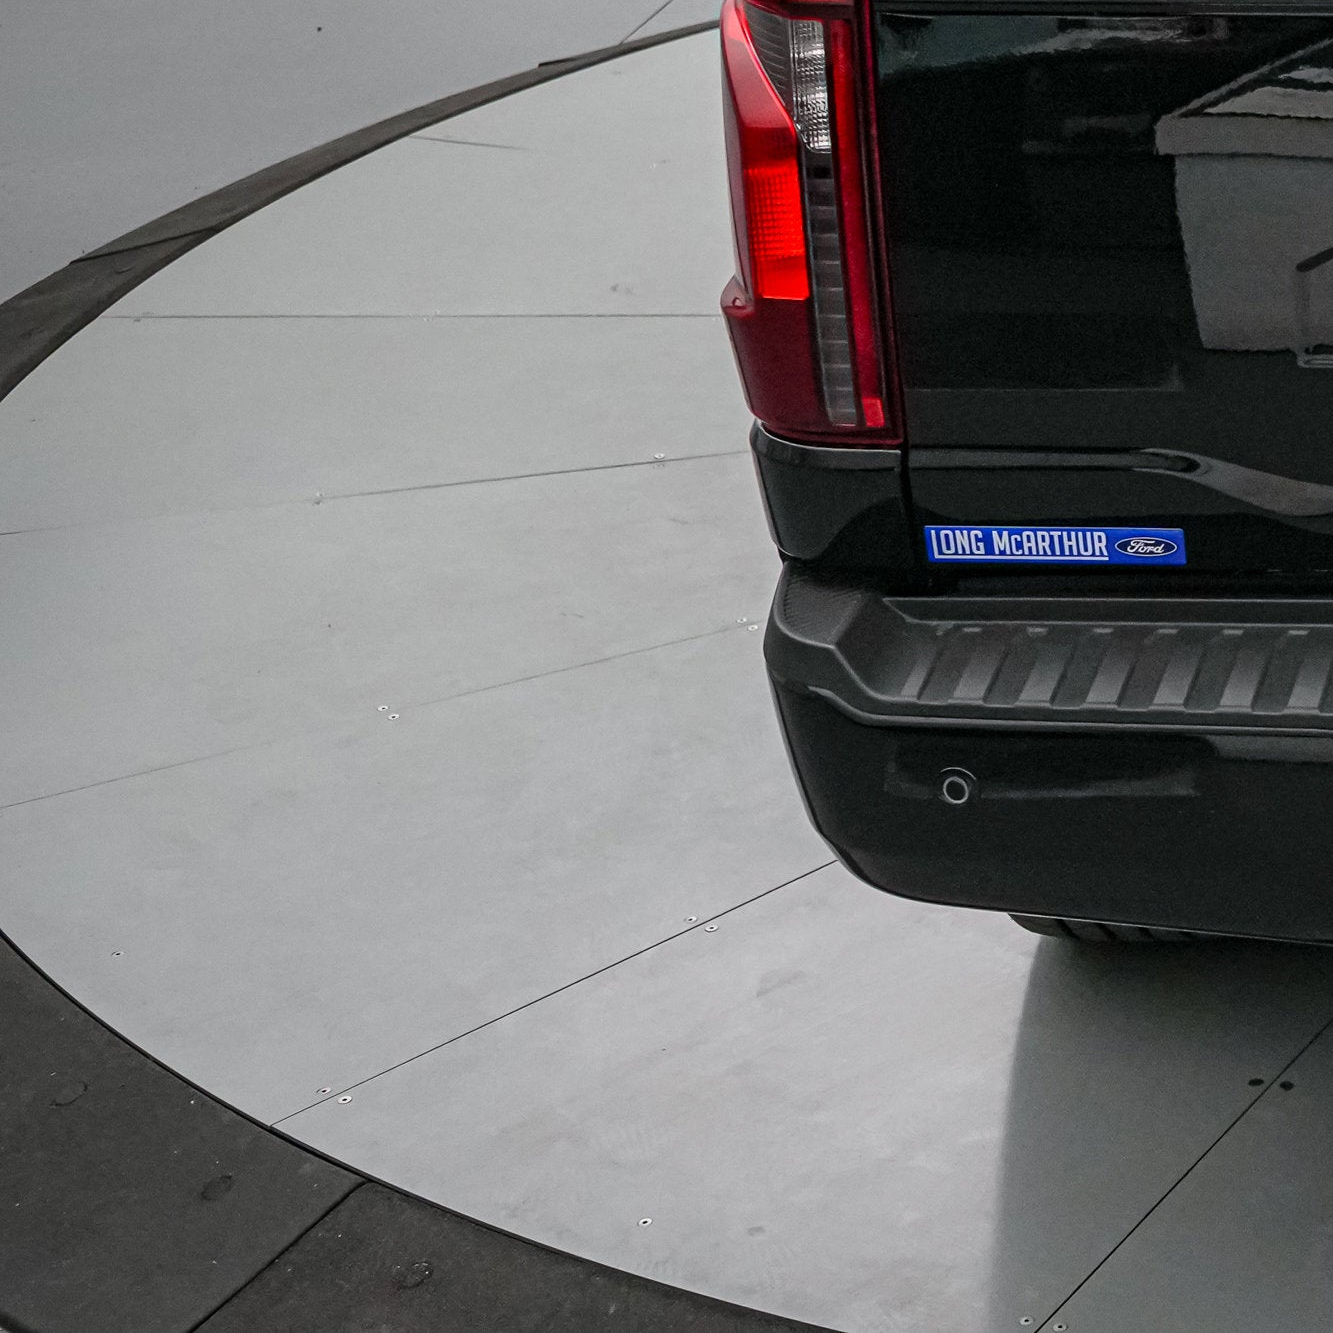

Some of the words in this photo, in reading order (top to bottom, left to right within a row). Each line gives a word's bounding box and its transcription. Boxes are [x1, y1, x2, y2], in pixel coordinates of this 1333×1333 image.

[930, 529, 984, 559] LONG
[992, 530, 1108, 556] McARTHUR
[1126, 539, 1165, 554] Ford
